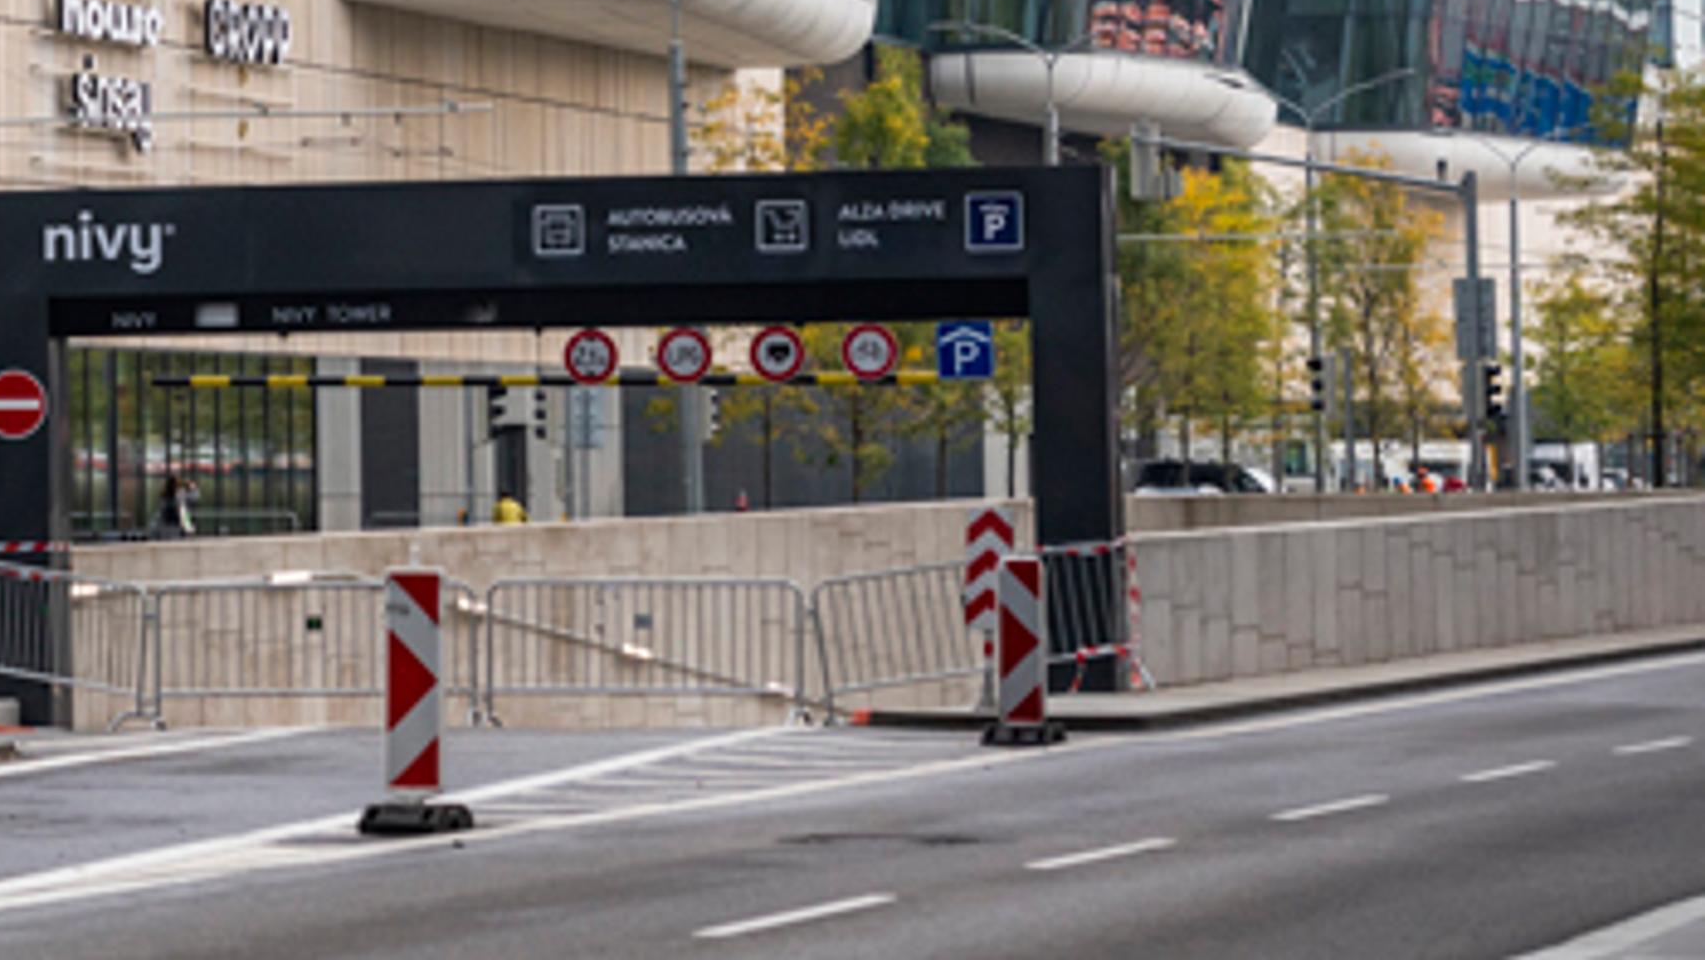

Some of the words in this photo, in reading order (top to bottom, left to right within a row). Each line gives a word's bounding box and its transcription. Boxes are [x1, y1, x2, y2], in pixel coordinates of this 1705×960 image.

[837, 202, 884, 220] ALZA
[888, 199, 946, 220] DRIVE
[607, 234, 687, 252] STANICA
[837, 229, 879, 247] LIDL
[111, 311, 158, 328] NIVY
[272, 306, 317, 323] NIVY
[326, 304, 392, 321] TOWER
[953, 340, 981, 376] P
